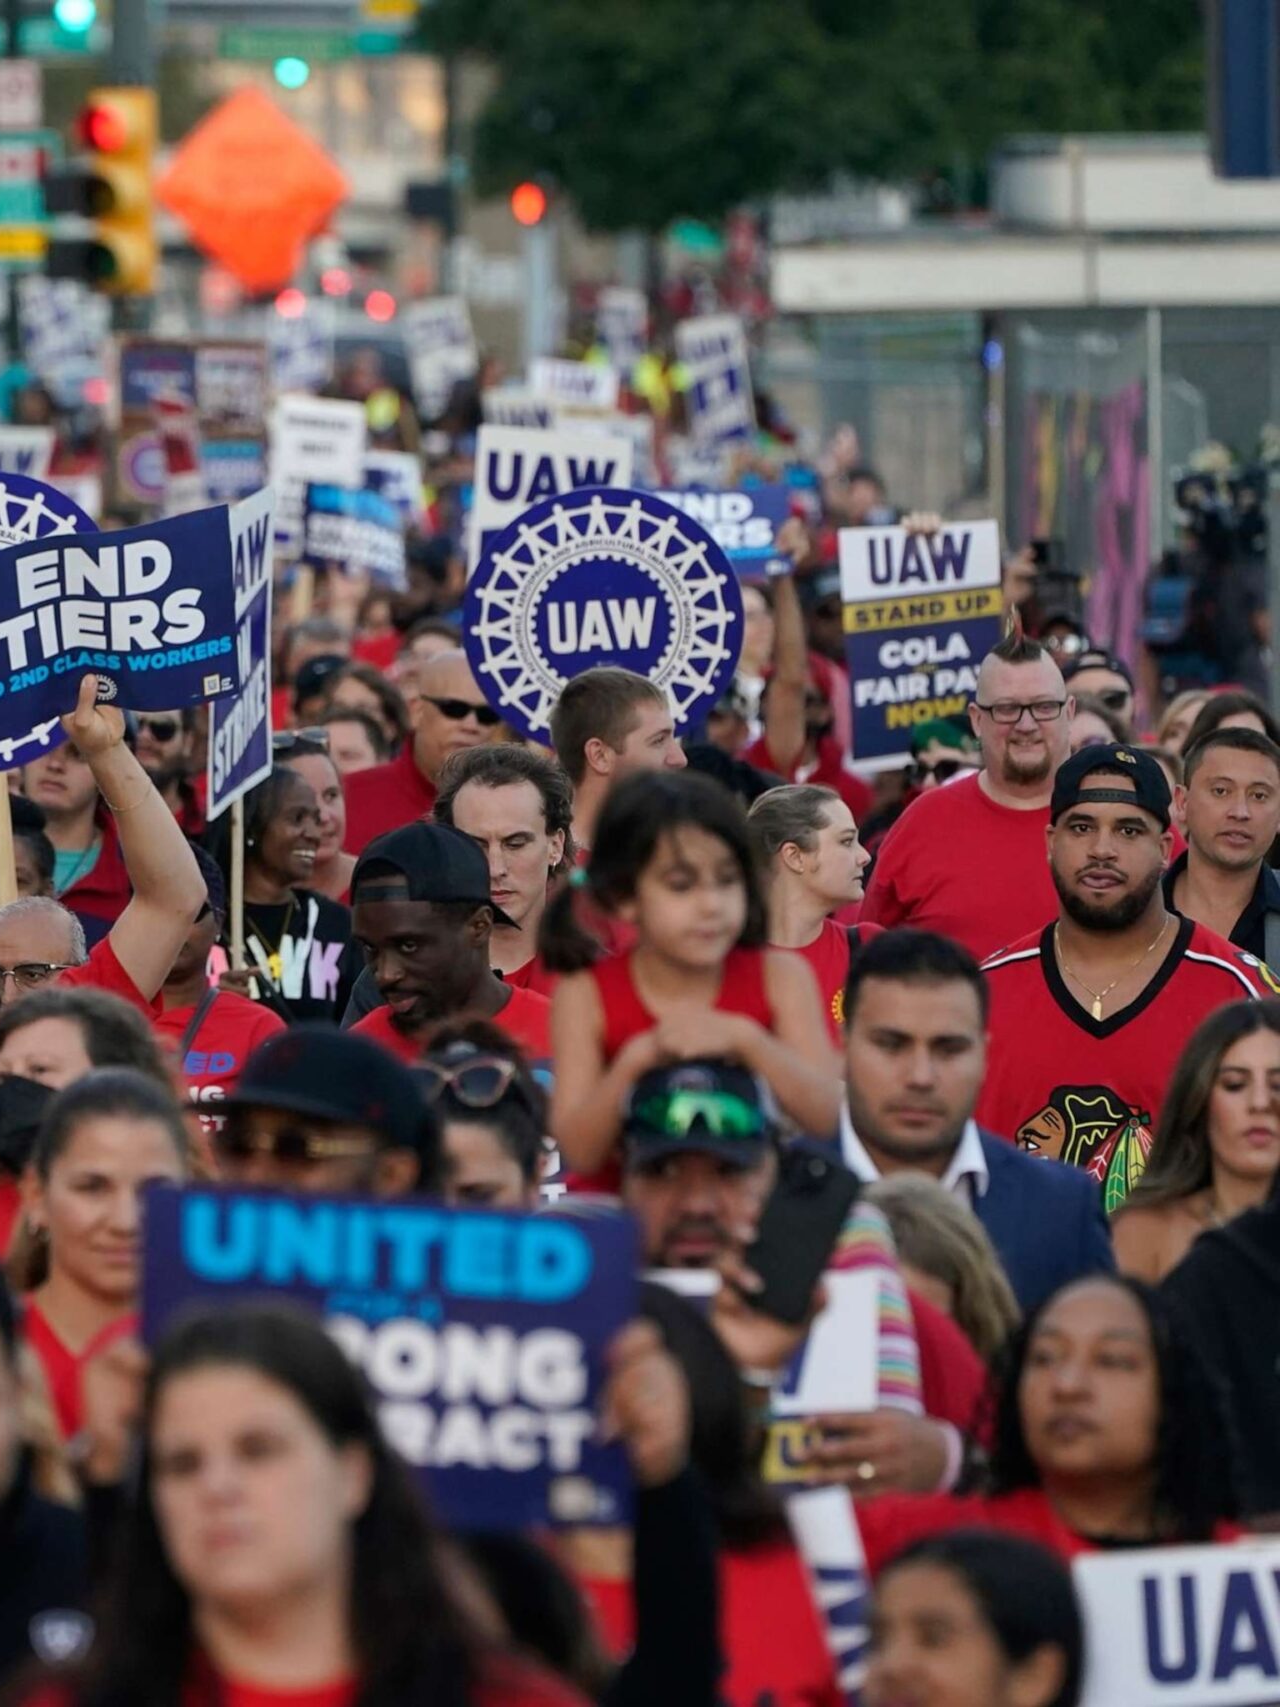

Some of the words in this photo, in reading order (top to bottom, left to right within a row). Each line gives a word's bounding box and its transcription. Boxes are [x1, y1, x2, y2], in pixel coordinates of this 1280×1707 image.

[15, 539, 173, 609] END
[868, 531, 970, 585] UAW
[547, 597, 657, 655] UAW
[854, 601, 946, 625] STAND
[955, 593, 991, 613] UP
[9, 667, 49, 693] 2ND
[53, 651, 121, 674] CLASS
[127, 635, 233, 671] WORKERS
[878, 631, 971, 669] COLA
[853, 672, 930, 708] FAIR
[885, 694, 967, 730] NOW
[213, 659, 266, 793] STRIKE
[181, 1193, 595, 1303] UNITED
